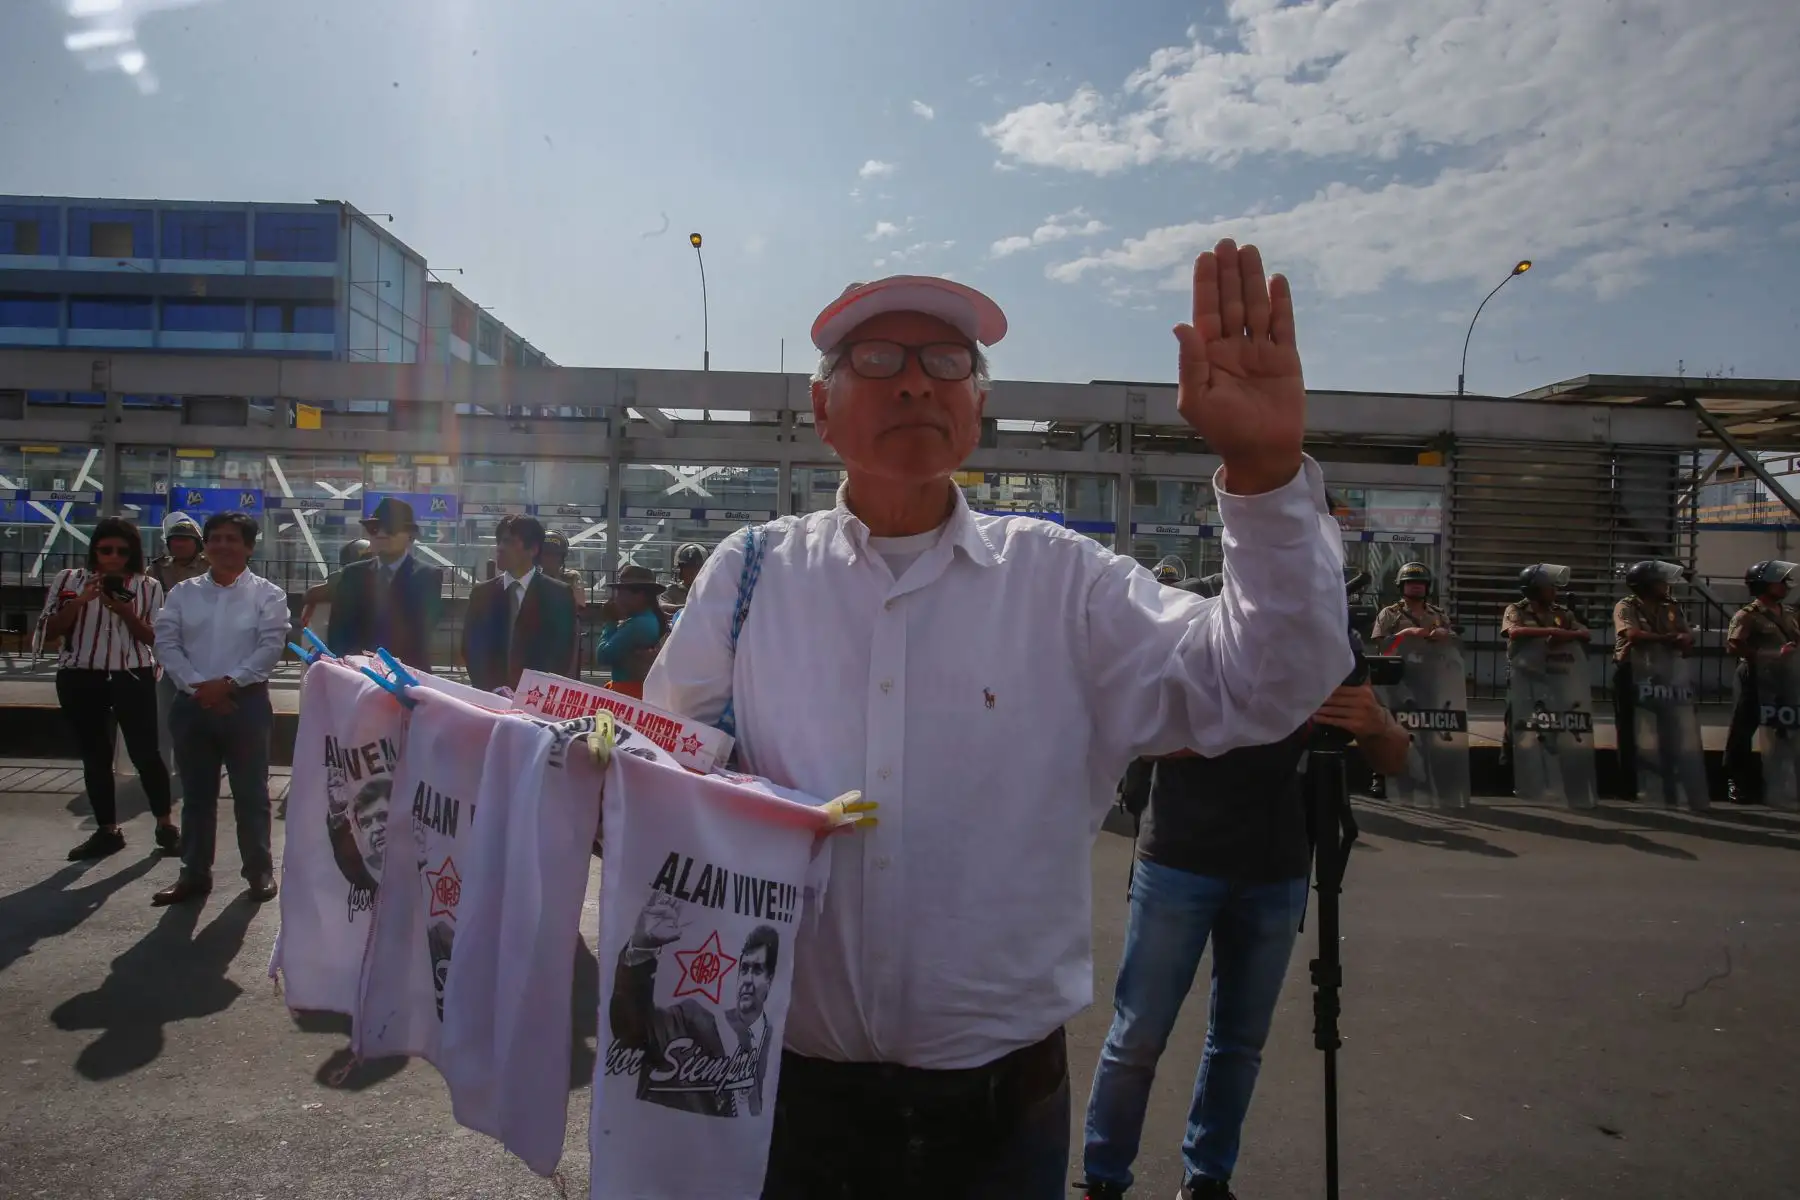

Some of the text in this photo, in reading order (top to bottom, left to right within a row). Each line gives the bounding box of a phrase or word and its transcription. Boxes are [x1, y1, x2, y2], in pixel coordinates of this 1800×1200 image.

[541, 684, 560, 715] EL
[1396, 711, 1459, 730] POLICIA
[412, 780, 460, 840] ALAN
[651, 851, 797, 924] ALAN VIVE!!!
